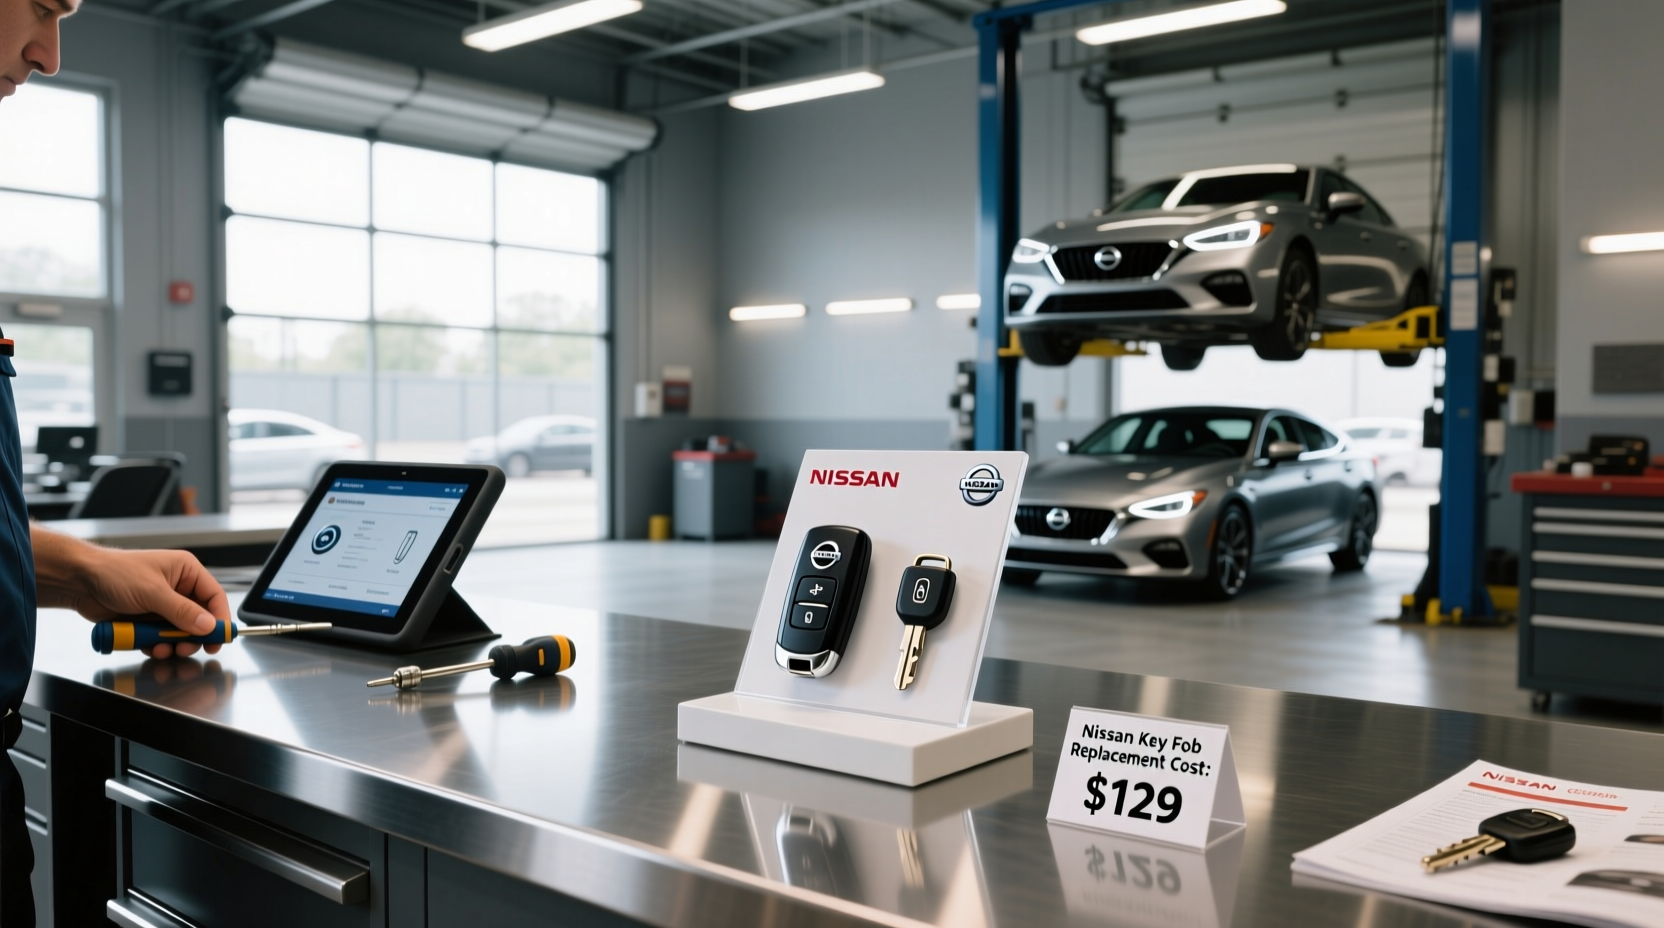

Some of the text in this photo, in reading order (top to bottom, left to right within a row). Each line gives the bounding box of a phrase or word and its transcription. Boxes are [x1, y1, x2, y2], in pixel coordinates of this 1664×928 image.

[809, 469, 900, 488] NISSAN
[1081, 724, 1202, 754] Nissan Key Fob
[1070, 742, 1211, 777] Replacement Cost:
[1083, 771, 1183, 824] $129
